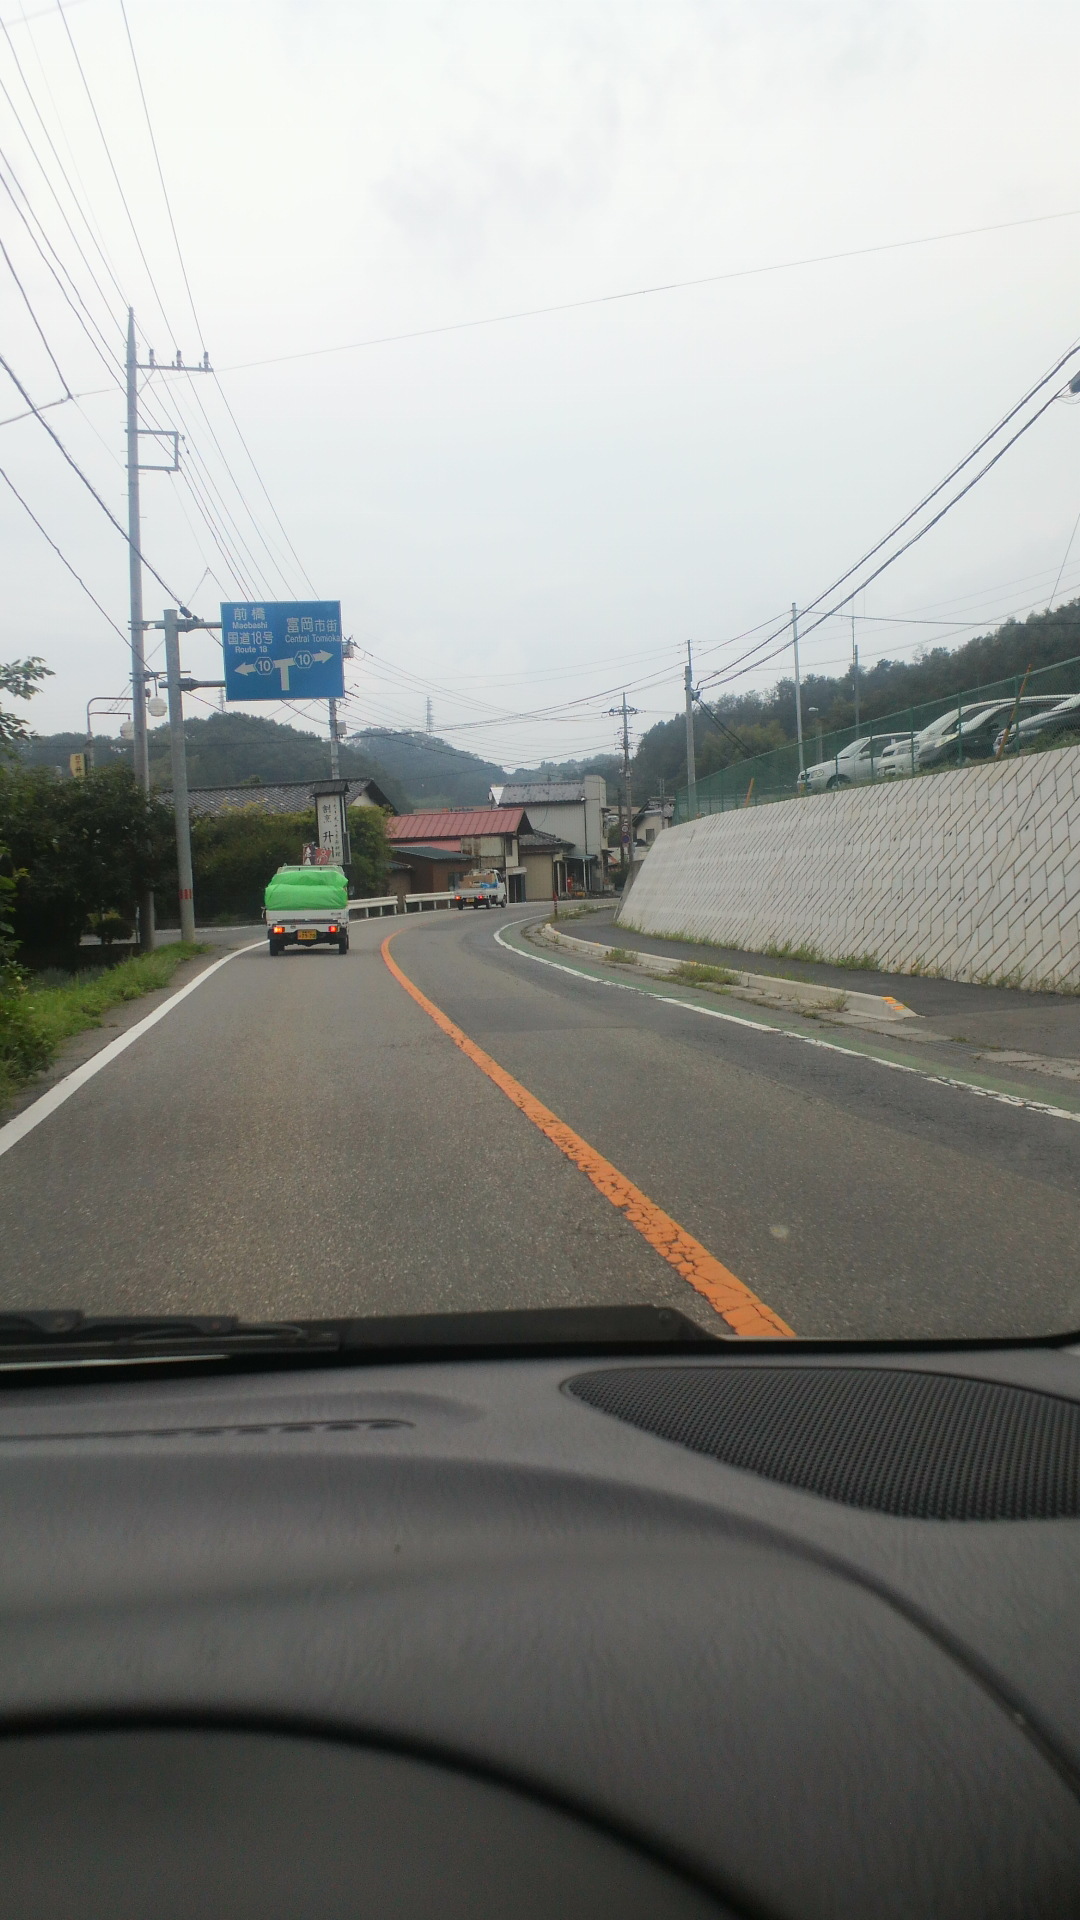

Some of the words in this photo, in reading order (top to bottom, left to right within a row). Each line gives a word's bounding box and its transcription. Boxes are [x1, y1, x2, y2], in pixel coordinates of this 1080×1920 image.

[234, 607, 265, 621] 前橋
[232, 621, 268, 629] Maebashi
[286, 616, 337, 633] 富岡市街
[227, 631, 274, 645] 国道18号
[284, 634, 310, 643] Central
[312, 633, 341, 643] Tomioka
[259, 645, 268, 653] 18
[298, 653, 310, 665] 10
[258, 660, 271, 672] 10
